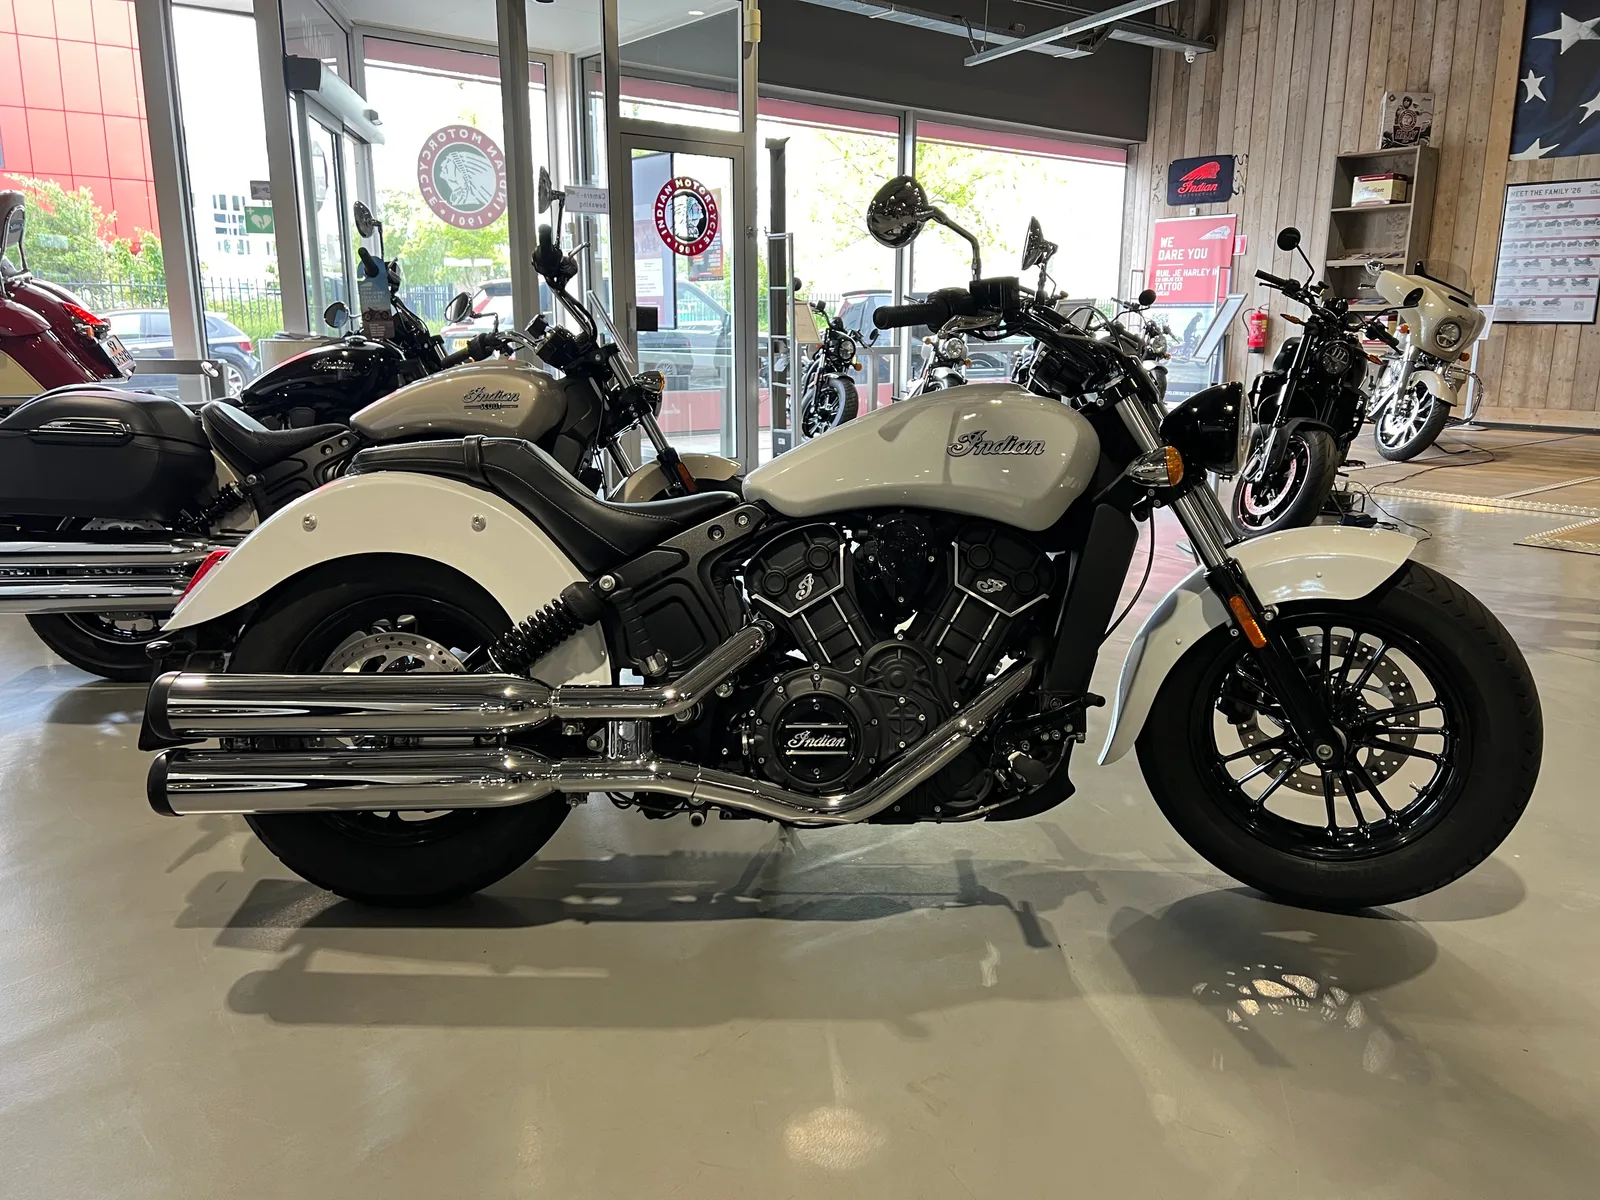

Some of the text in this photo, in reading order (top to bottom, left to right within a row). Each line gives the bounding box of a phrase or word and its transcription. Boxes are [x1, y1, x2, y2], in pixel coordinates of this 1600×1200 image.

[1177, 180, 1218, 193] Indian
[1511, 190, 1529, 198] MEET
[656, 178, 717, 244] INDIAN MOTORCYCLE
[674, 242, 697, 254] 1901
[1160, 236, 1175, 248] WE
[1158, 248, 1208, 261] DARE YOU
[1156, 269, 1171, 277] RUIL
[1172, 269, 1182, 277] JE
[1183, 268, 1211, 277] HARLEY
[1155, 282, 1183, 291] TATTOO
[462, 386, 521, 403] Indian
[946, 430, 1046, 457] Indian
[787, 730, 847, 748] Indian
